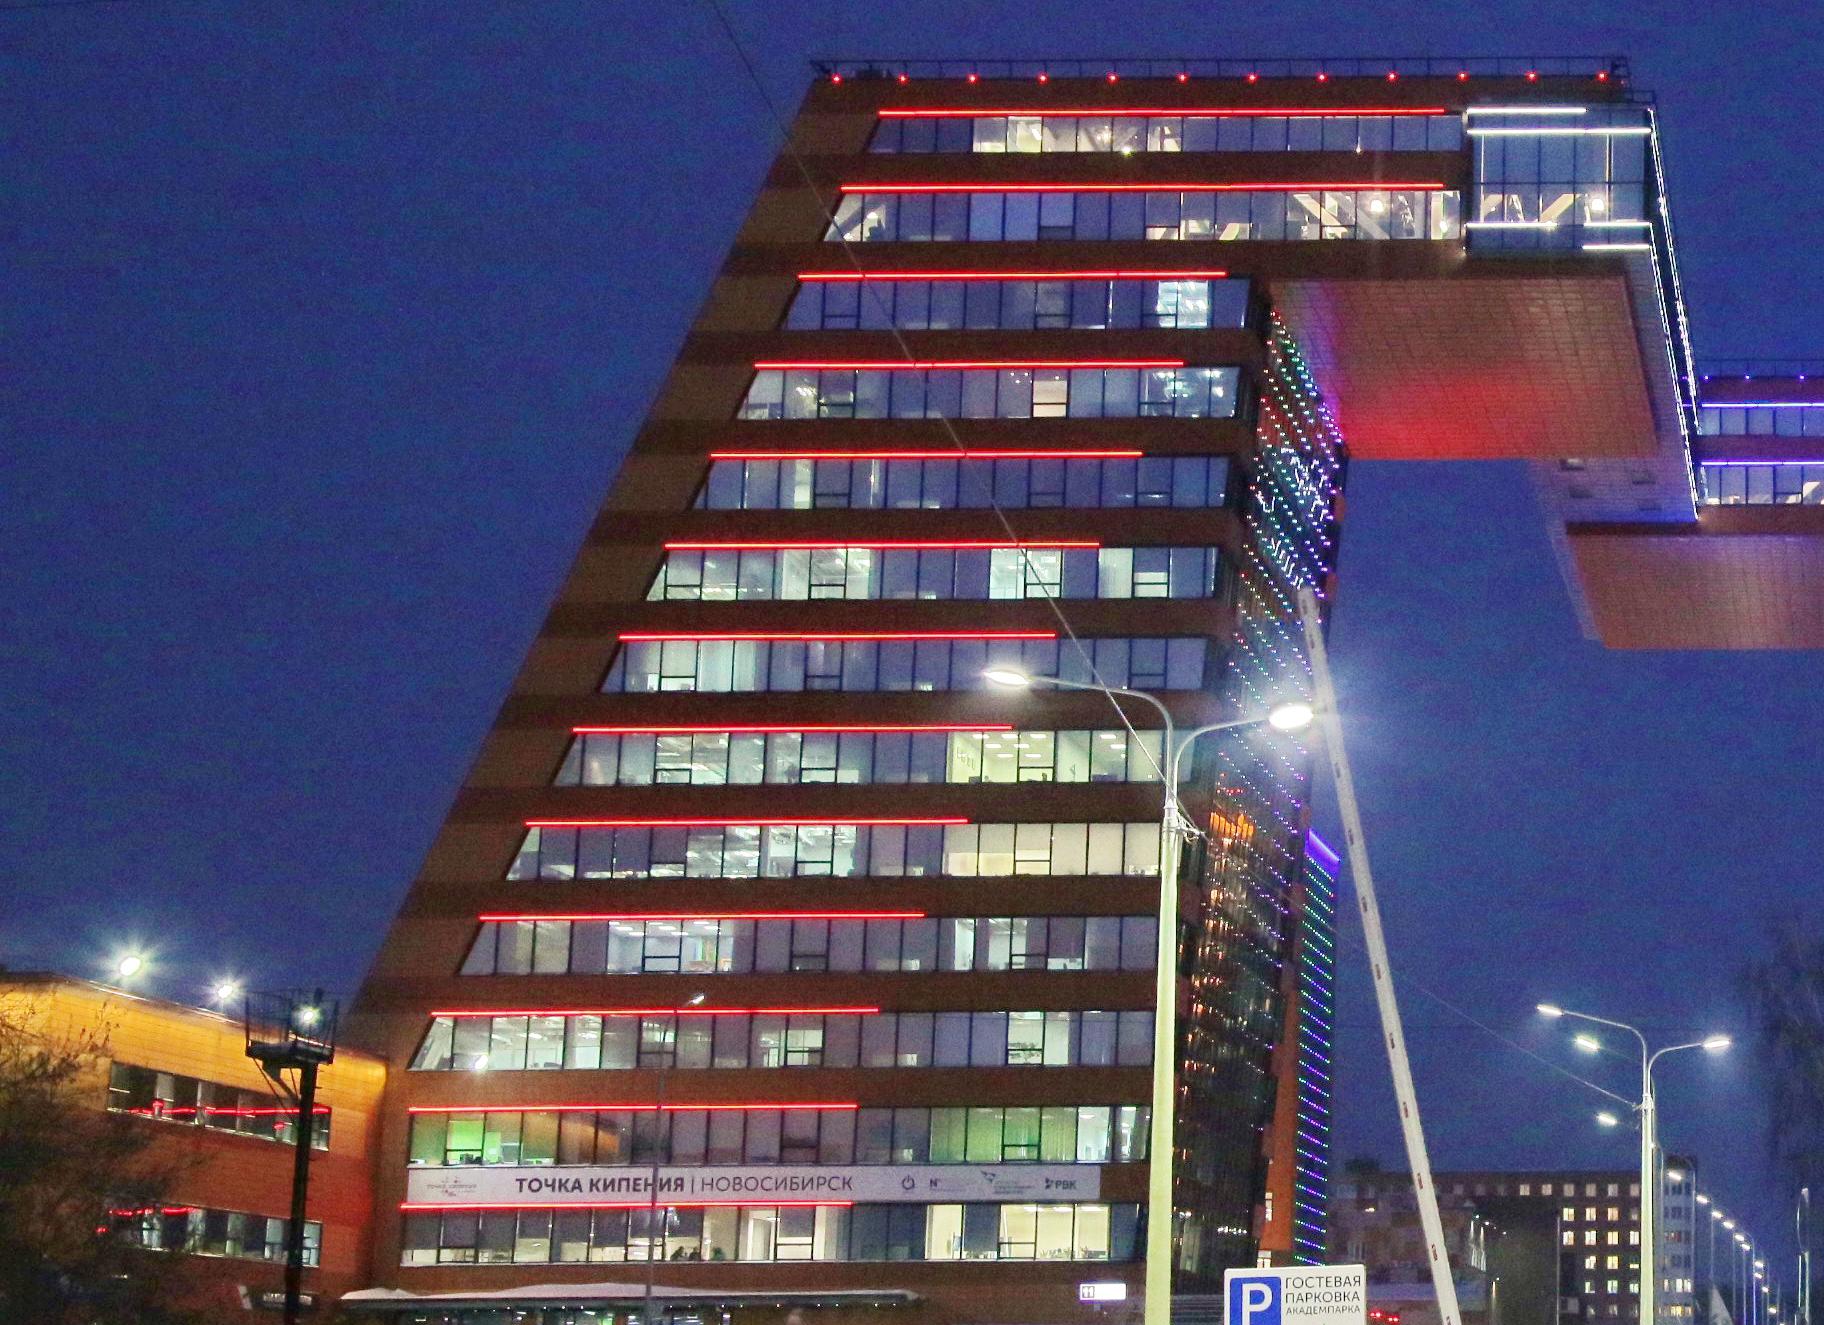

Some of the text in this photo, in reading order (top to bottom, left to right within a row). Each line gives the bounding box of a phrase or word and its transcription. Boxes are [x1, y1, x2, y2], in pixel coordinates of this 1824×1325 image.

[515, 1176, 853, 1193] ТОЧКА КИПЕНИЯ НОВОСИБИРСК
[1285, 1275, 1361, 1289] ГОСТЕВАЯ
[1242, 1283, 1273, 1325] P
[1285, 1291, 1360, 1304] ПАРКОВКА
[1286, 1305, 1360, 1315] АКАДЕМПАРКА
